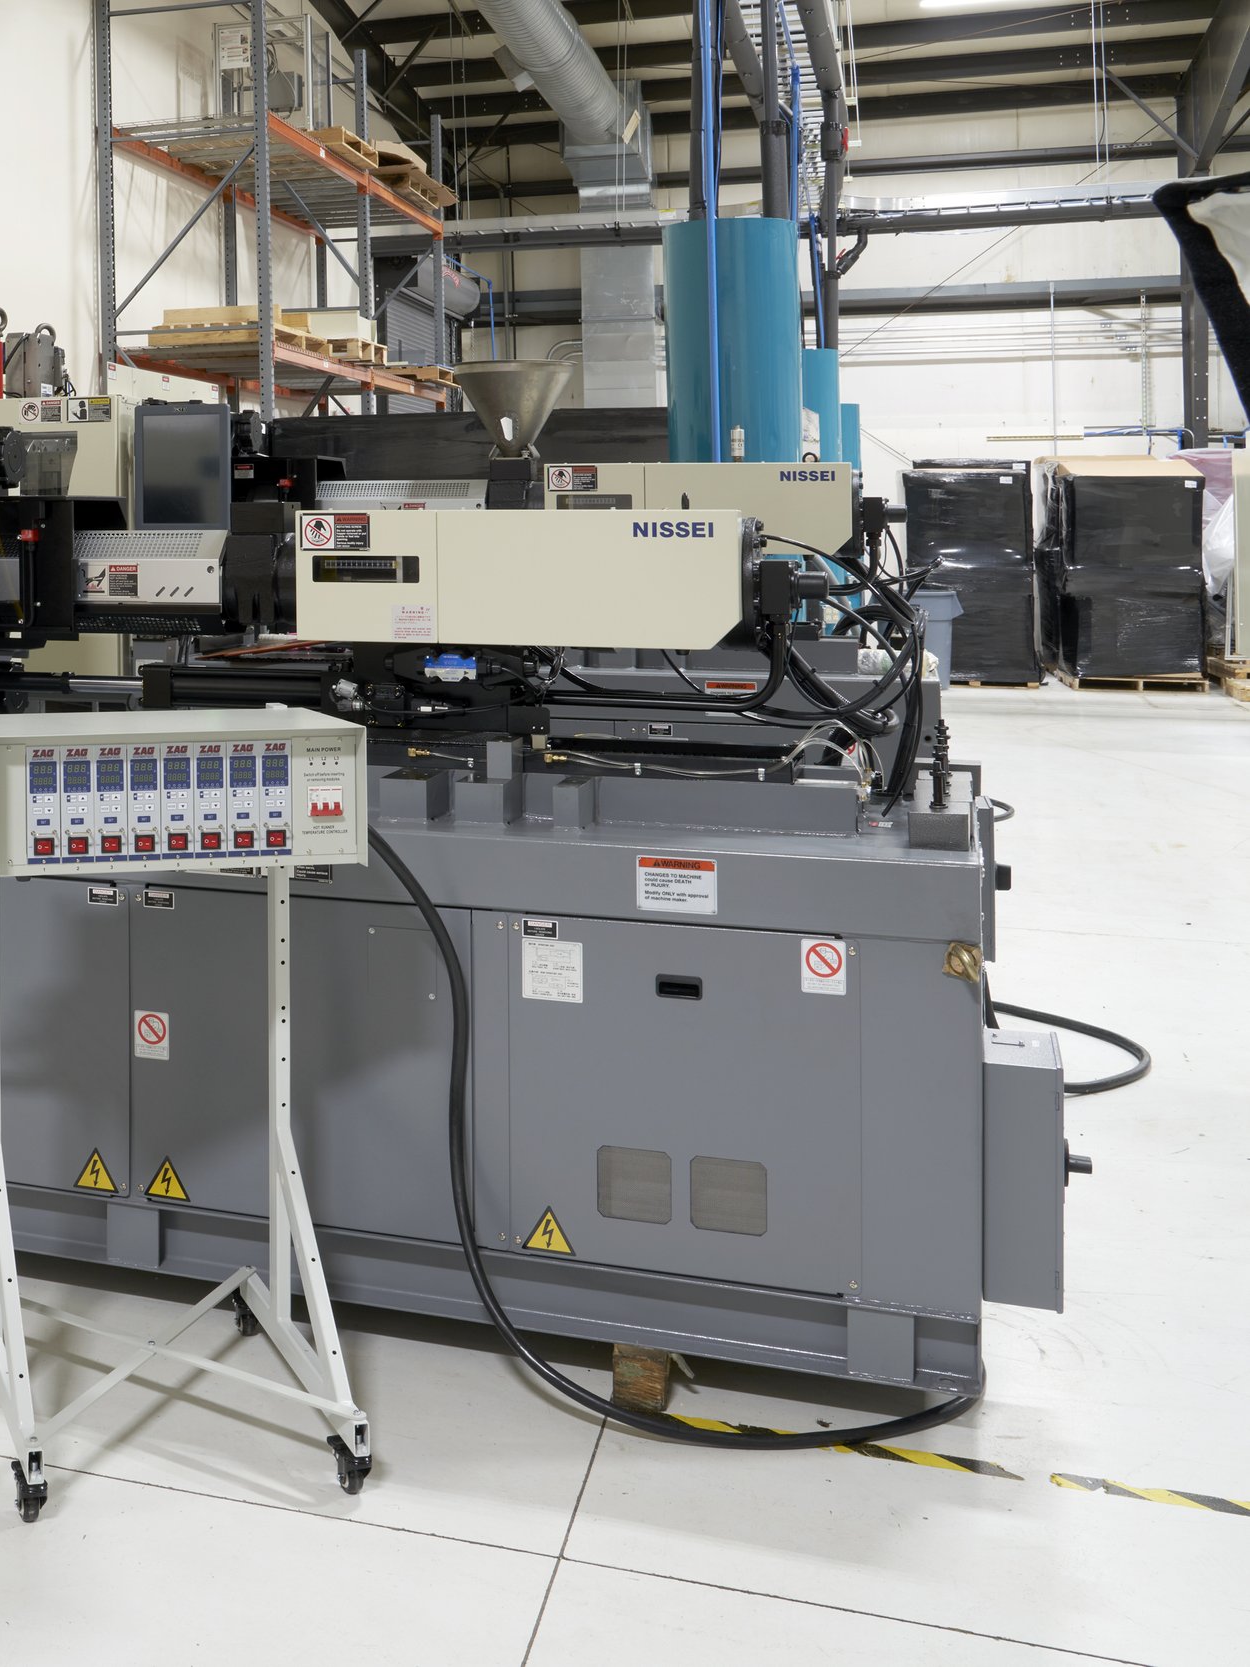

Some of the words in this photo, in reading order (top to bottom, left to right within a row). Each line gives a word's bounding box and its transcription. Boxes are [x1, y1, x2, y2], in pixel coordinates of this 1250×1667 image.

[780, 470, 835, 481] NISSEI
[633, 522, 714, 538] NISSEI
[99, 748, 121, 756] ZAG
[133, 747, 155, 755] ZAG
[167, 746, 188, 754] ZAG
[200, 745, 221, 754] ZAG
[232, 744, 254, 752] ZAG
[264, 743, 286, 752] ZAG
[32, 749, 54, 758] ZAG
[66, 749, 88, 757] ZAG
[662, 860, 700, 869] WARNING
